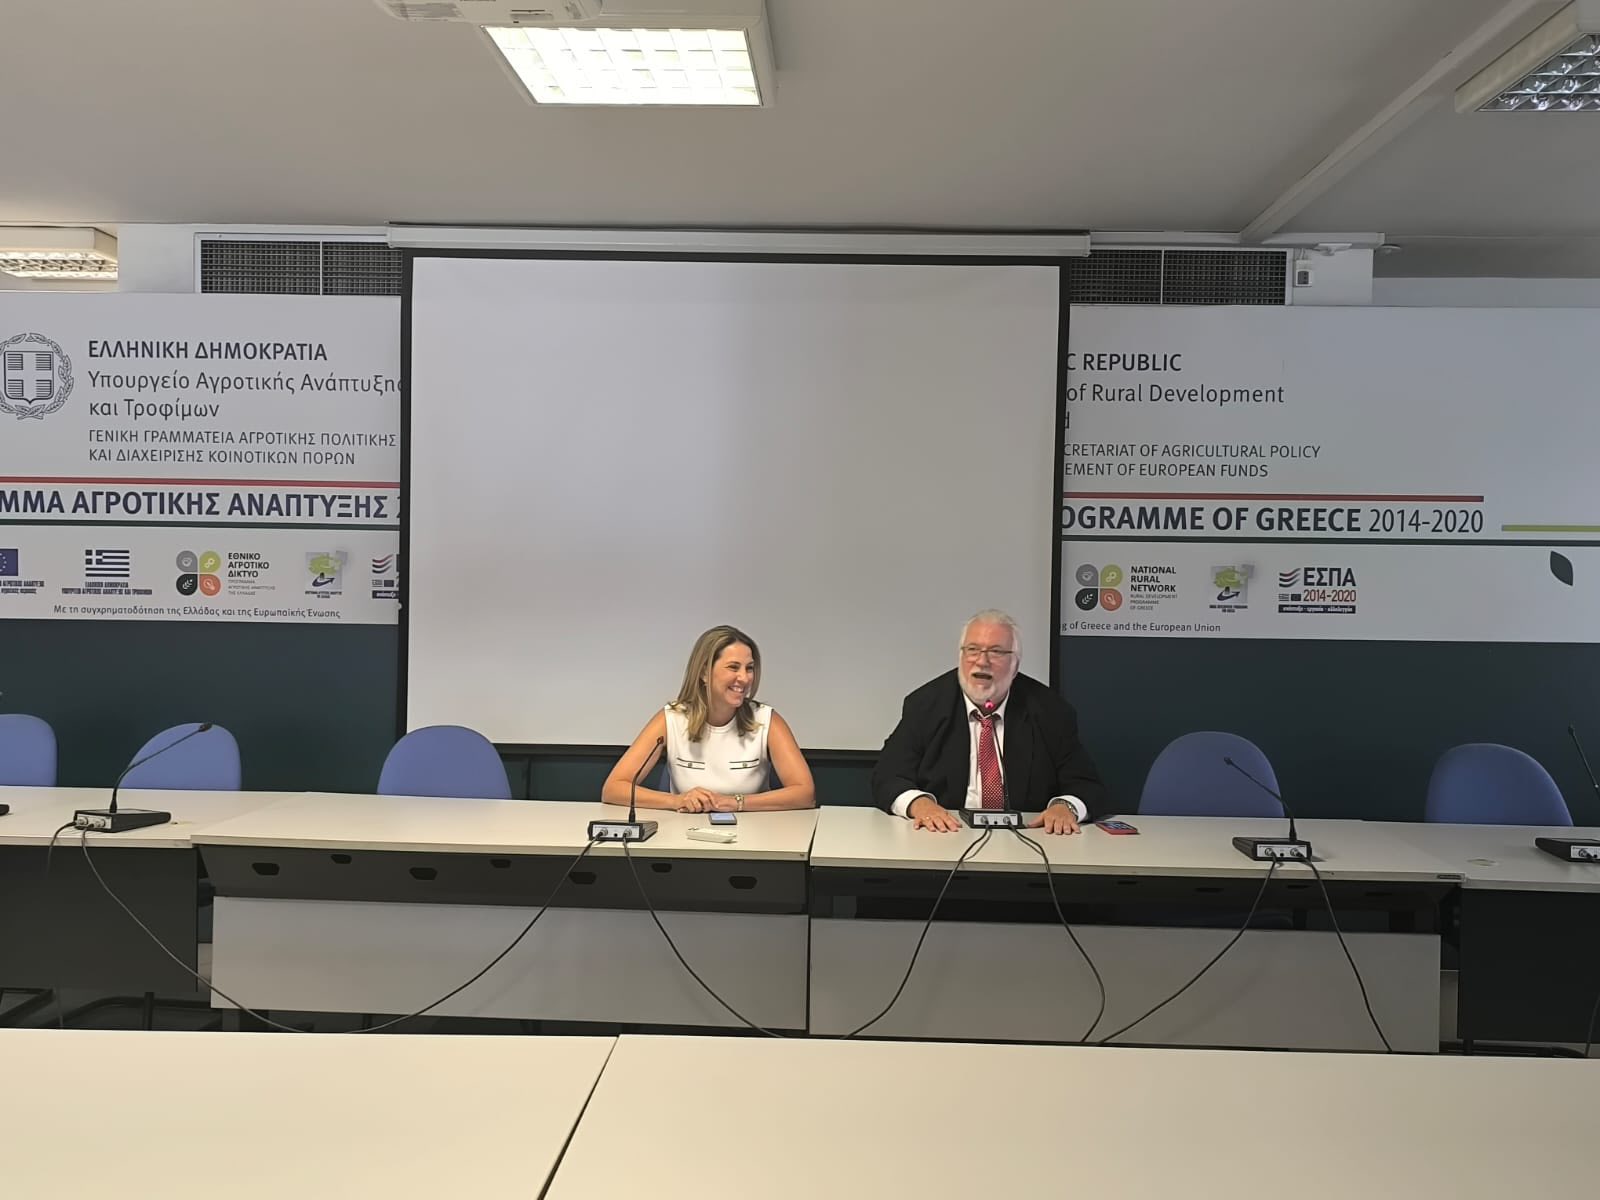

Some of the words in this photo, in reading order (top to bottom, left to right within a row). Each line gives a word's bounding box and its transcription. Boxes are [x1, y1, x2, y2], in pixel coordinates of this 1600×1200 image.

[89, 341, 188, 358] ΕΛΛΗΝΙΚΗ
[195, 342, 327, 360] ΔΗΜΟΚΡΑΤΙΑ
[1083, 354, 1181, 371] REPUBLIC
[88, 370, 189, 392] Υπουργείο
[196, 371, 294, 394] Αγροτικής
[1067, 383, 1087, 401] of
[1093, 384, 1142, 401] Rural
[1150, 384, 1284, 406] Development
[90, 403, 118, 415] και
[124, 398, 219, 421] Τροφίμων
[90, 430, 138, 442] ΓΕΝΙΚΗ
[145, 430, 234, 443] ΓΡΑΜΜΑΤΕΙΑ
[239, 432, 316, 445] ΑΓΡΟΤΙΚΗΣ
[321, 433, 396, 446] ΠΟΛΙΤΙΚΗΣ
[90, 449, 111, 461] ΚΑΙ
[116, 449, 203, 462] ΔΙΑΧΕΙΡΙΣΗΣ
[209, 451, 297, 464] ΚΟΙΝΟΤΙΚΩΝ
[303, 452, 354, 464] ΠΟΡΩΝ
[1140, 444, 1158, 456] OF
[1161, 445, 1266, 457] AGRICULTURAL
[1270, 445, 1320, 458] POLICY
[1065, 463, 1113, 476] EMENT
[1117, 464, 1136, 475] OF
[1140, 464, 1215, 476] EUROPEAN
[1221, 464, 1268, 477] FUNDS
[72, 491, 220, 515] ΑΓΡΟΤΙΚΗΣ
[228, 493, 388, 518] ΑΝΑΠΤΥΞΗΣ
[1213, 507, 1248, 530] OF
[1256, 508, 1361, 531] GREECE
[1369, 509, 1483, 533] 2014-2020
[228, 561, 270, 569] ΑΓΡΟΤΙΚΟ
[1131, 566, 1176, 574] NATIONAL
[1304, 567, 1356, 586] ΕΣΠΑ
[1303, 589, 1356, 602] 2014-2020
[54, 605, 66, 613] Με
[81, 605, 164, 615] συγχρηματοδότηση
[167, 608, 181, 616] της
[183, 606, 219, 616] Ελλάδας
[238, 609, 251, 617] της
[305, 609, 340, 619] Ένωσης
[1070, 621, 1078, 629] of
[1081, 622, 1111, 630] Greece
[1114, 622, 1130, 630] and
[1133, 622, 1147, 630] the
[1150, 623, 1192, 633] European
